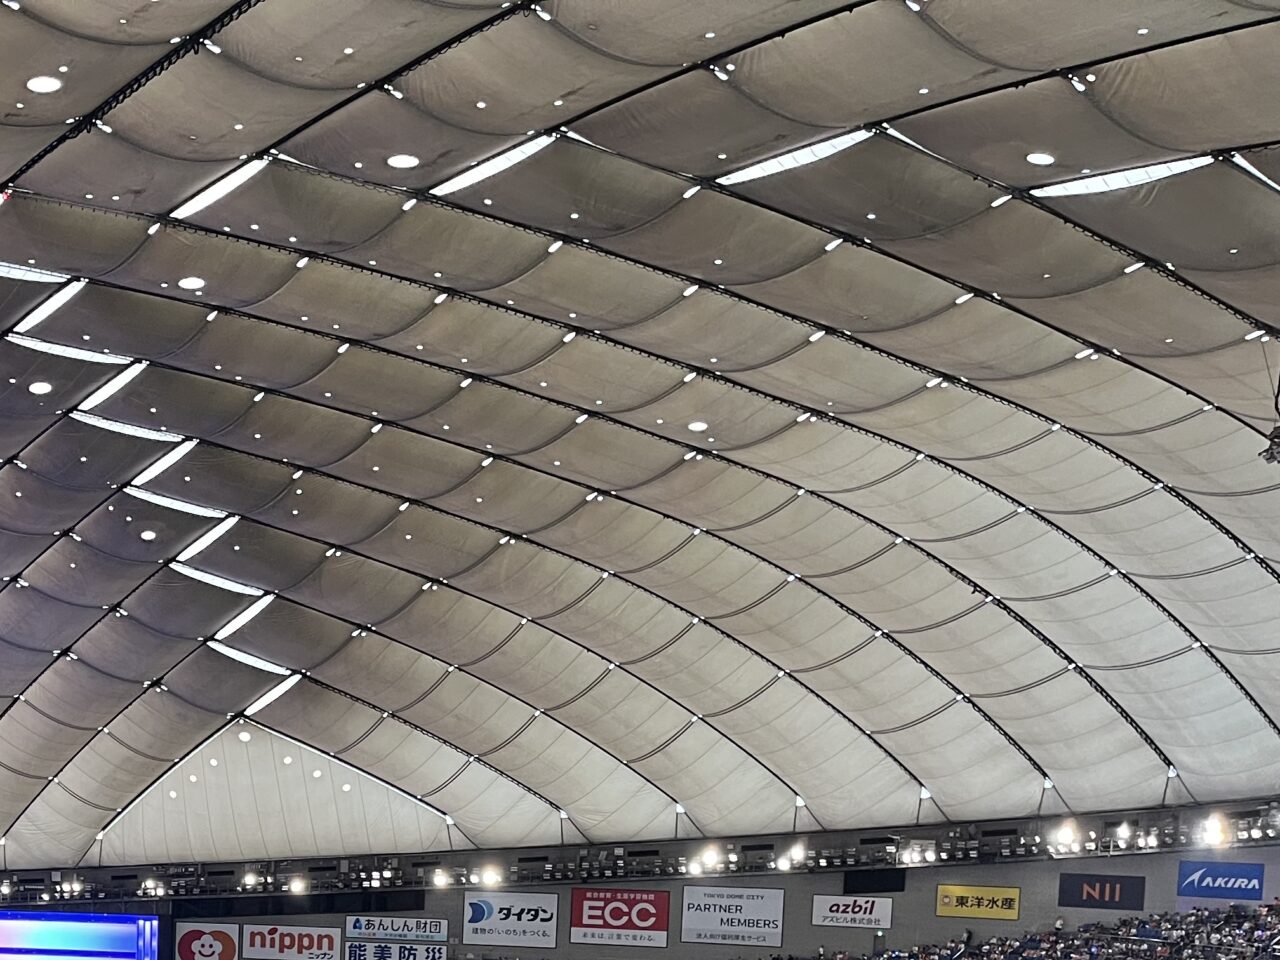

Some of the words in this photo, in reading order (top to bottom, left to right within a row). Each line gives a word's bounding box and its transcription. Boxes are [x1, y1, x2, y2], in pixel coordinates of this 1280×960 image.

[1201, 876, 1260, 890] AKIRA
[687, 902, 743, 914] PARTNER
[828, 899, 876, 915] azbil
[954, 895, 1016, 910] 東洋水産
[497, 904, 554, 923] ダイダン
[582, 900, 657, 928] ECC
[821, 915, 882, 926] アズビル株式会社
[364, 918, 442, 934] あんしん財団
[720, 917, 779, 929] MEMBERS
[249, 926, 335, 954] nippn
